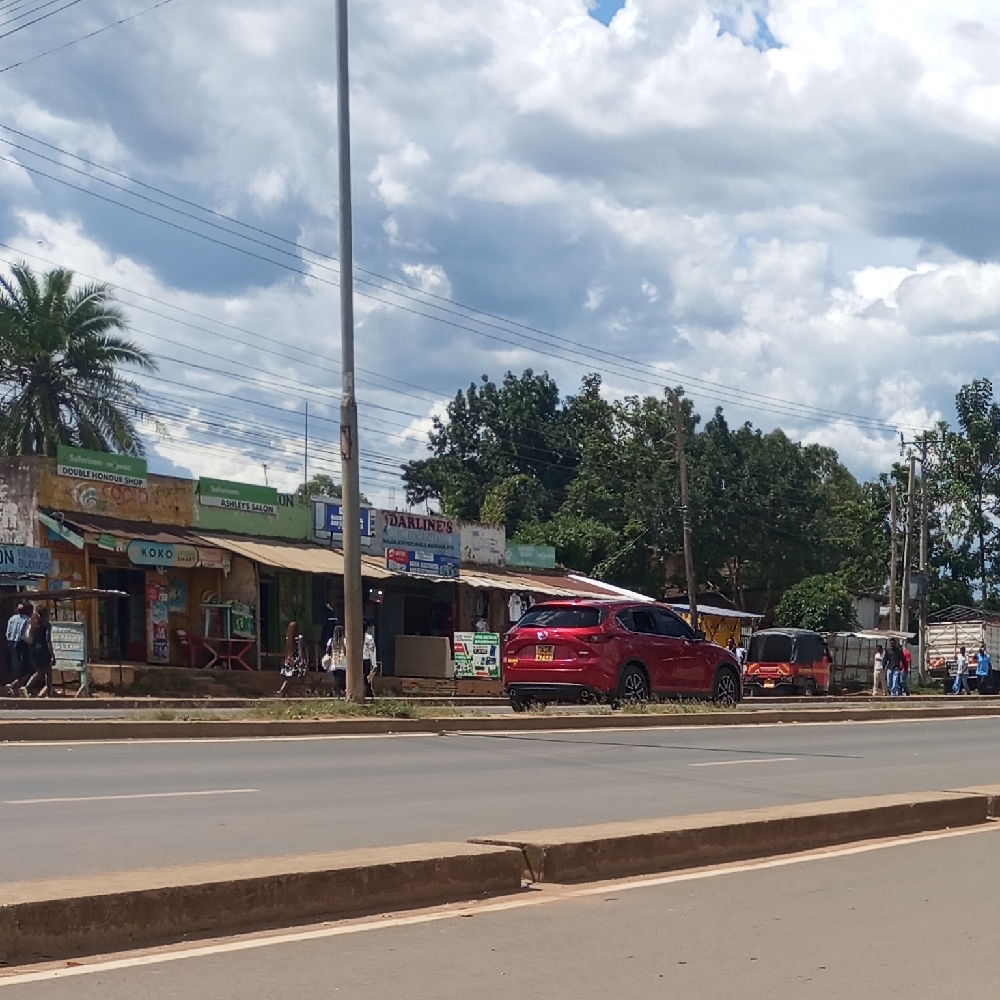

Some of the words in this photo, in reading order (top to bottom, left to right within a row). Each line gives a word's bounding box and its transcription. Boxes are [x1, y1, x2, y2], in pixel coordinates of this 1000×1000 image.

[62, 466, 90, 478] DOUBLE
[91, 471, 122, 482] HONOUR
[125, 477, 143, 486] SHOP
[220, 499, 250, 510] ASHLEY'S
[252, 503, 274, 513] SALON
[277, 493, 295, 508] ON
[389, 513, 453, 534] DARLINE'S
[141, 547, 173, 559] KOKO
